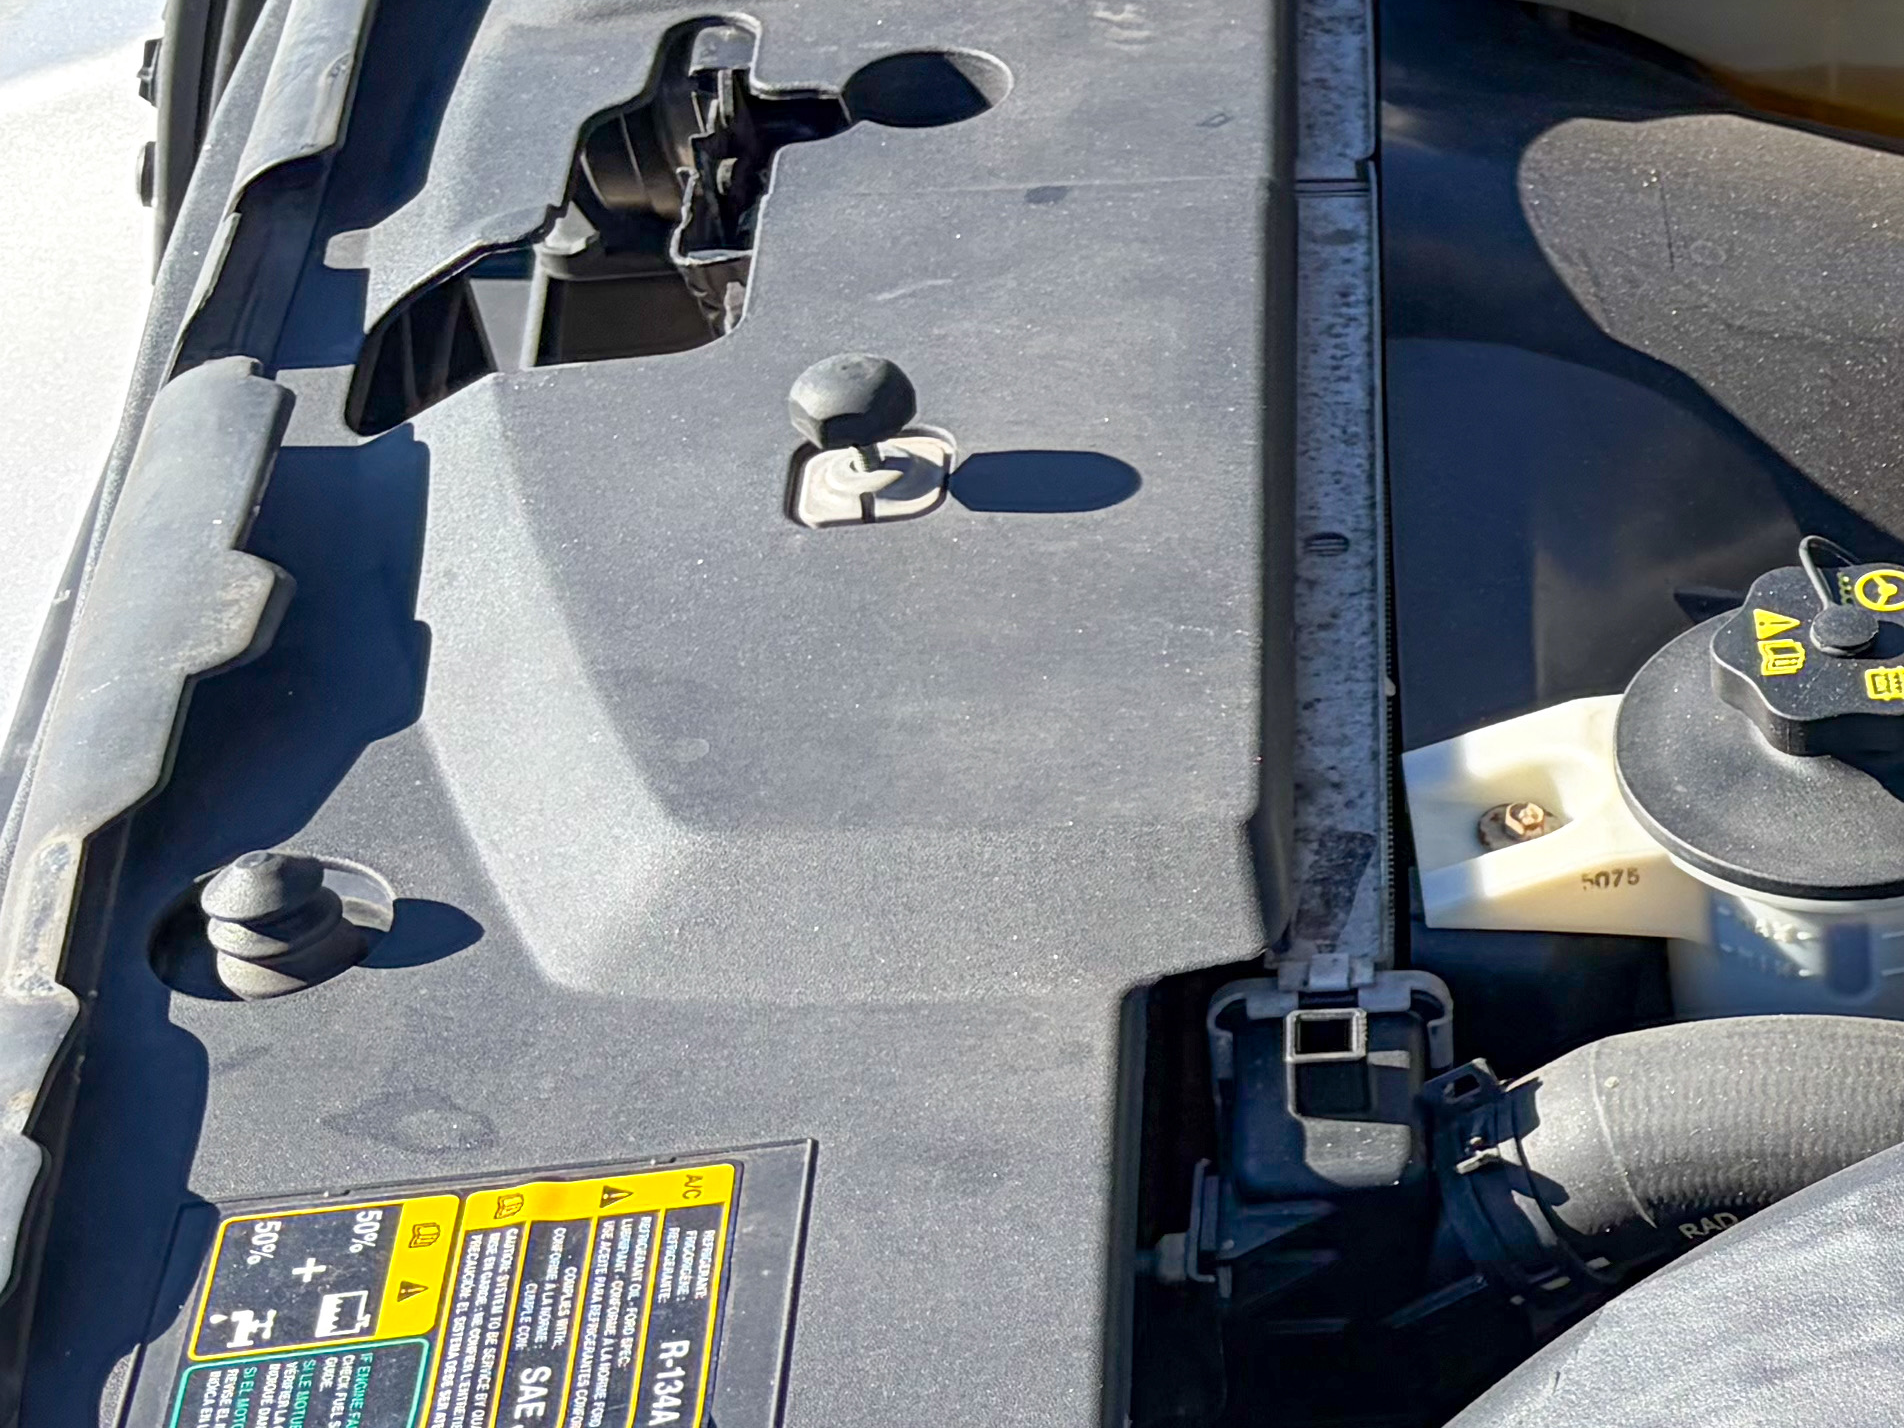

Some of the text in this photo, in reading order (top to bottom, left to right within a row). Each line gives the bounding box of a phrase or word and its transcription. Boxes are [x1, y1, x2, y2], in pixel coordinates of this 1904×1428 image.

[1581, 867, 1641, 891] 5075
[682, 1172, 704, 1200] A/C
[244, 1219, 282, 1265] 50%
[347, 1208, 384, 1253] 50%
[491, 1275, 509, 1314] SYSTEM
[621, 1306, 637, 1335] FORD
[348, 1365, 370, 1411] ENGINE
[511, 1365, 552, 1419] SAE
[647, 1339, 690, 1425] R-134A
[329, 1391, 346, 1419] FUEL
